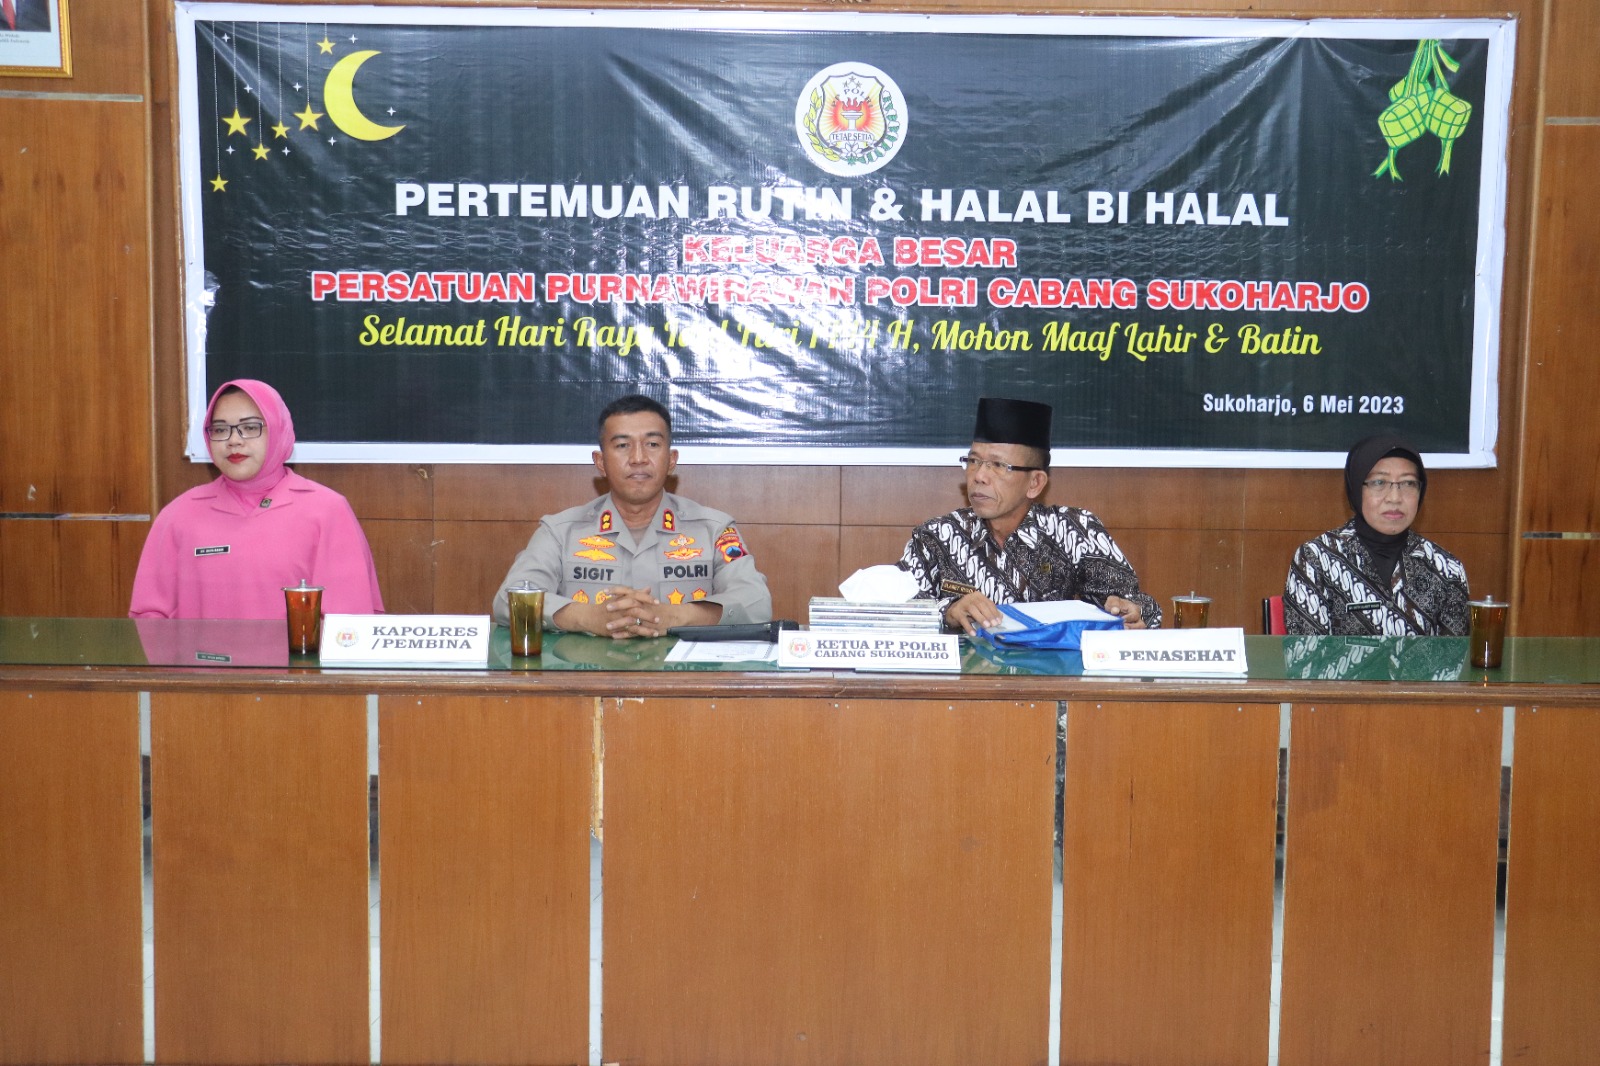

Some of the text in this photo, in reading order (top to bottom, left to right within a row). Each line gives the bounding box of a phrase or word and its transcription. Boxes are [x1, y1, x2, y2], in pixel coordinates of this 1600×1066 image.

[395, 183, 1290, 227] PERTEMUAN RUTIN & HALAL BI HALAL
[682, 234, 1018, 269] KELUARGA BESAR
[310, 271, 1370, 313] PERSATUAN PURNAWIRAWAN POLRI CABANG SUKOHARJO
[358, 314, 487, 347] Selamat
[494, 316, 566, 347] Hari
[887, 319, 921, 354] H,
[930, 321, 1033, 353] Mohon
[1041, 321, 1123, 361] Maaf
[1124, 322, 1198, 362] Lahir
[1204, 325, 1229, 353] &
[1237, 324, 1322, 356] Batin
[1202, 393, 1405, 418] Sukoharjo, 6 Mei 2023
[573, 566, 614, 582] SIGIT
[663, 564, 708, 579] POLRI
[372, 626, 478, 637] KAPOLRES
[371, 638, 472, 650] /PEMBINA
[816, 639, 948, 652] KETUA PP POLRI
[814, 650, 950, 661] CABANG SUKOHARJO
[1118, 650, 1236, 662] PENASEHAT
